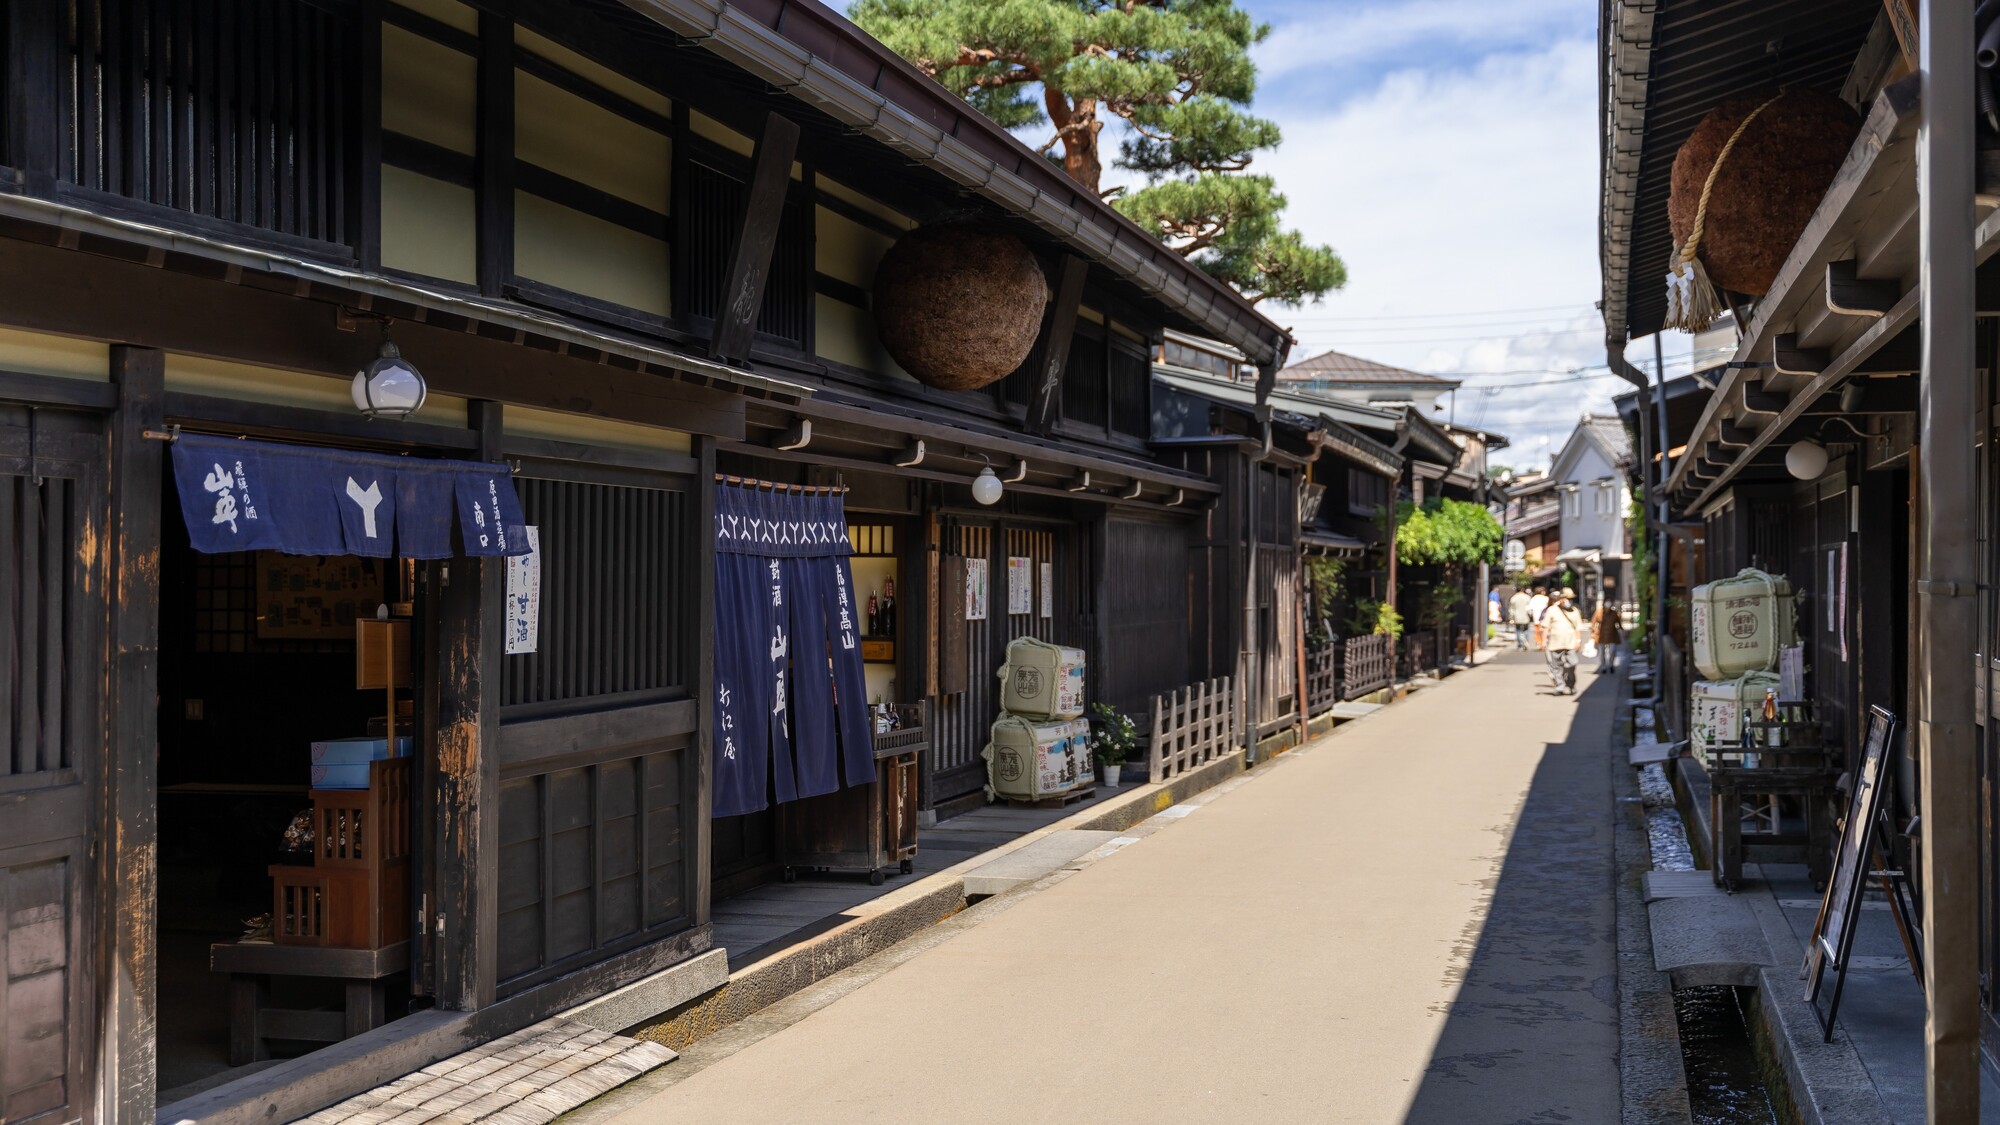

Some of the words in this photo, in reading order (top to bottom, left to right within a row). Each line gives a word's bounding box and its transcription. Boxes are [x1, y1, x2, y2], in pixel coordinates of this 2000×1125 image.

[203, 462, 239, 534] 山車
[474, 501, 489, 548] 南口
[769, 558, 783, 607] 銘酒
[835, 563, 855, 650] 飛騨高山
